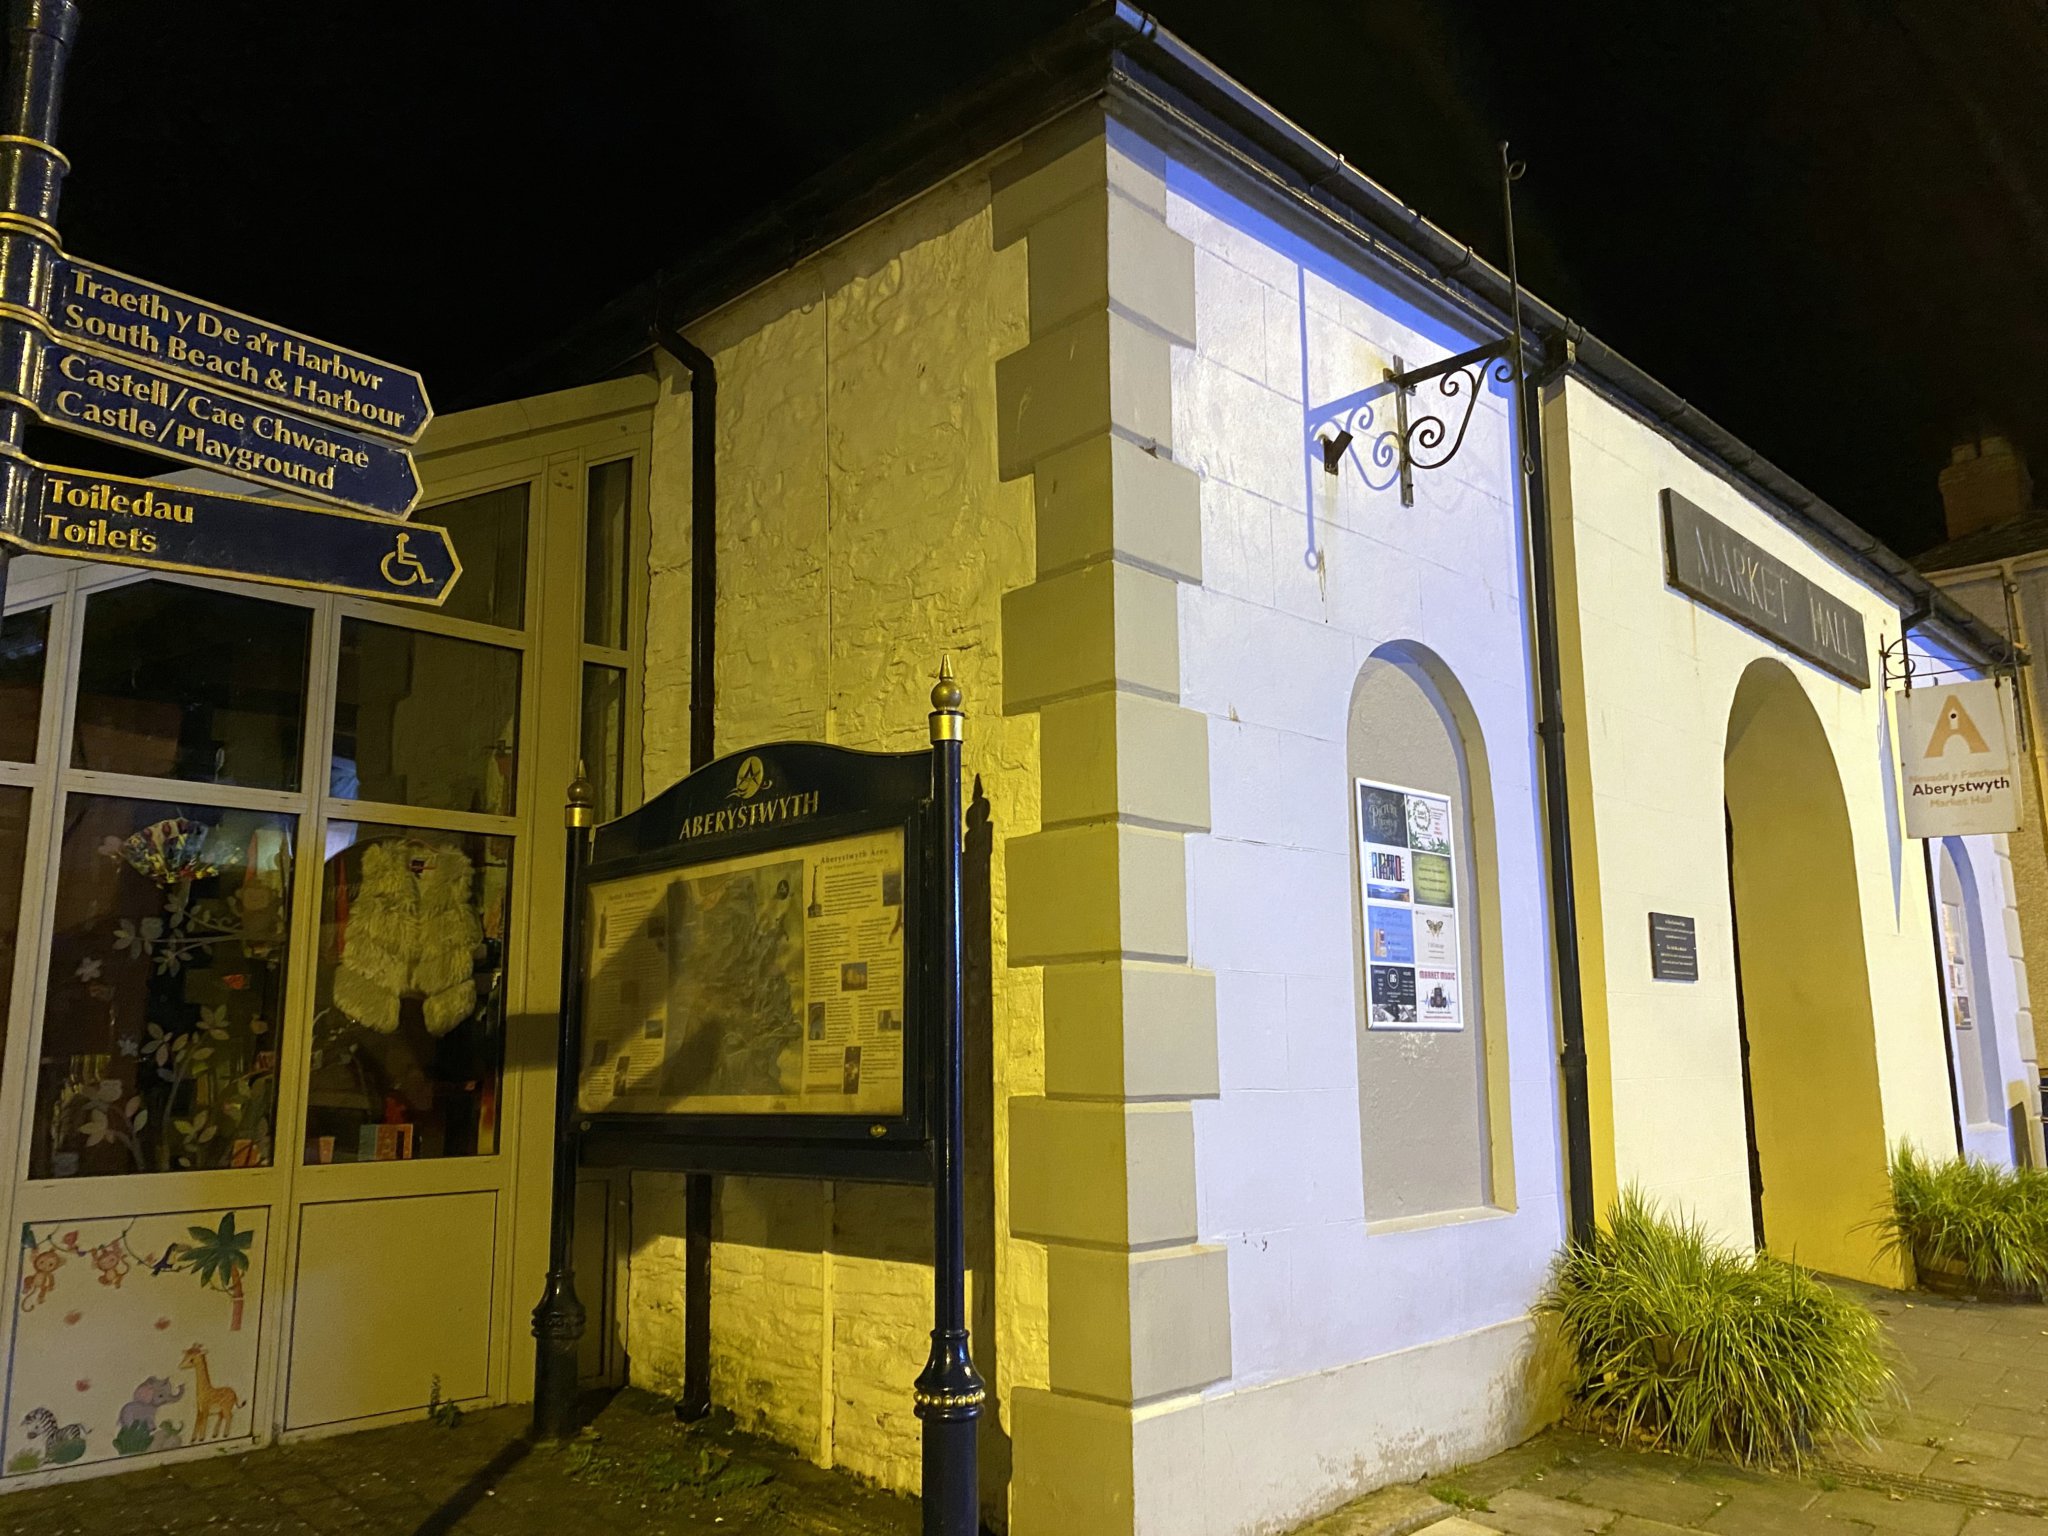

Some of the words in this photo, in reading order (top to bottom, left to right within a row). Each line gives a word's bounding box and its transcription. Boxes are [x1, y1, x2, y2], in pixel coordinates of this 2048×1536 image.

[71, 269, 169, 322] Traeth
[173, 307, 192, 332] y
[199, 312, 240, 344] De
[248, 332, 279, 357] a'r
[283, 339, 383, 391] Harbwr
[65, 305, 159, 353] South
[169, 335, 259, 384] Beach
[265, 367, 288, 392] &
[294, 375, 405, 428] Harbour
[253, 416, 369, 468] Chwarae
[47, 478, 194, 524] Toiledau
[45, 514, 158, 553] Toilets
[1695, 526, 1789, 624] MARKET
[1809, 594, 1857, 664] HALL
[1912, 776, 2010, 796] Aberystwyth
[679, 790, 819, 840] ABERYSTWYTH
